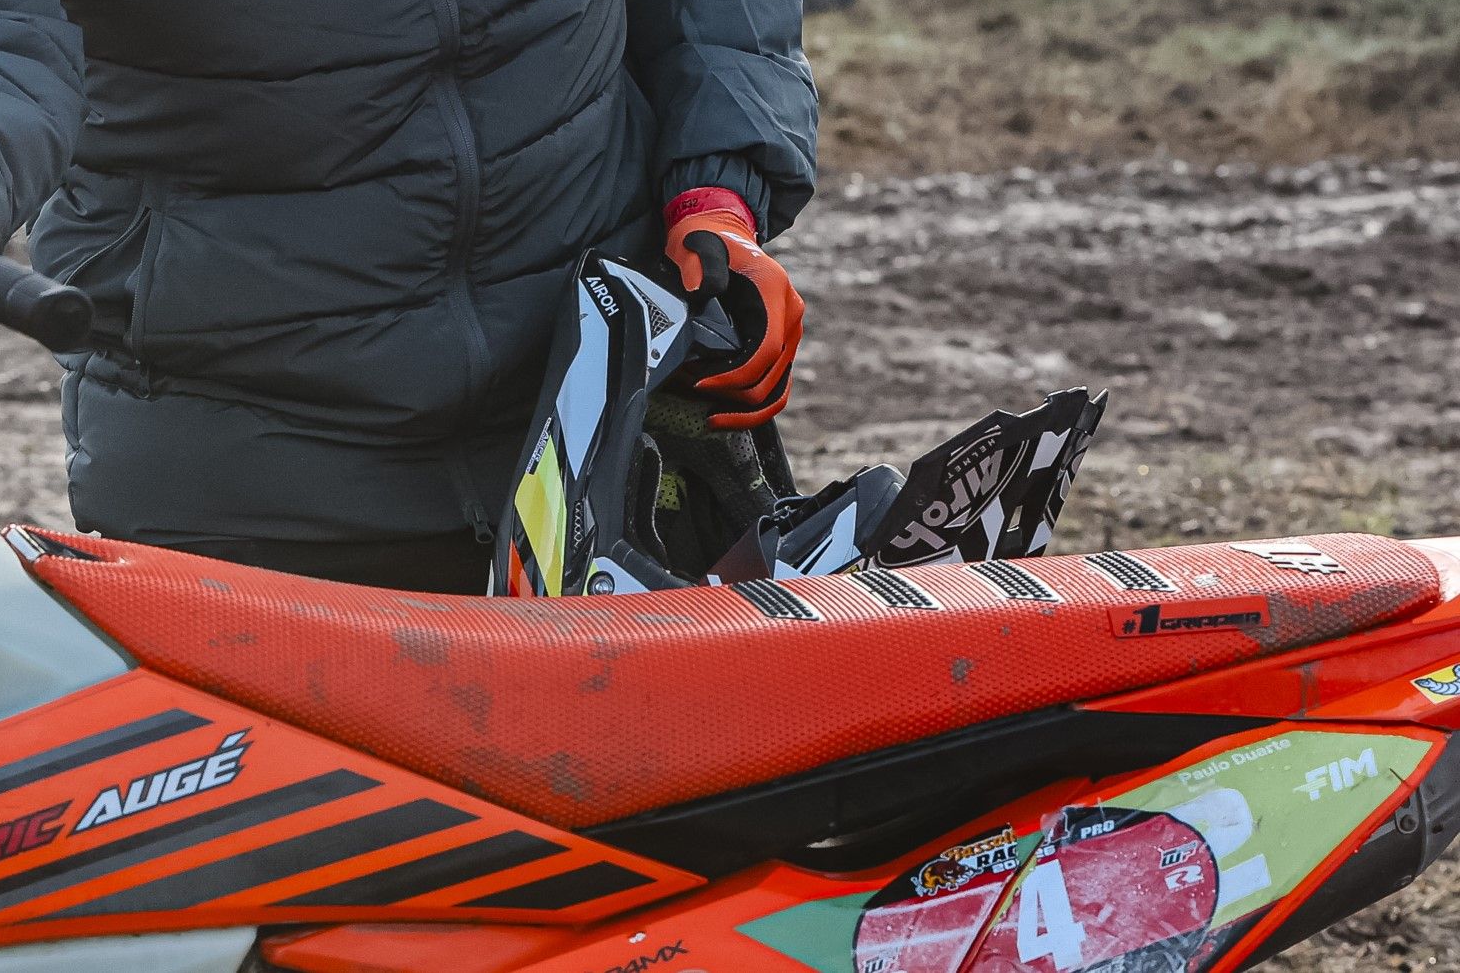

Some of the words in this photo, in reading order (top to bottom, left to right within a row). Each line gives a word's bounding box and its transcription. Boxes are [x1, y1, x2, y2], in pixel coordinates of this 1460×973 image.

[586, 277, 619, 317] AIROH
[69, 728, 251, 835] AUGÉ
[1179, 761, 1230, 785] Paulo
[1231, 739, 1291, 765] Duarte
[1293, 747, 1378, 801] FIM
[1080, 820, 1115, 839] PRO
[977, 845, 1018, 868] RAC
[1016, 858, 1086, 971] 4
